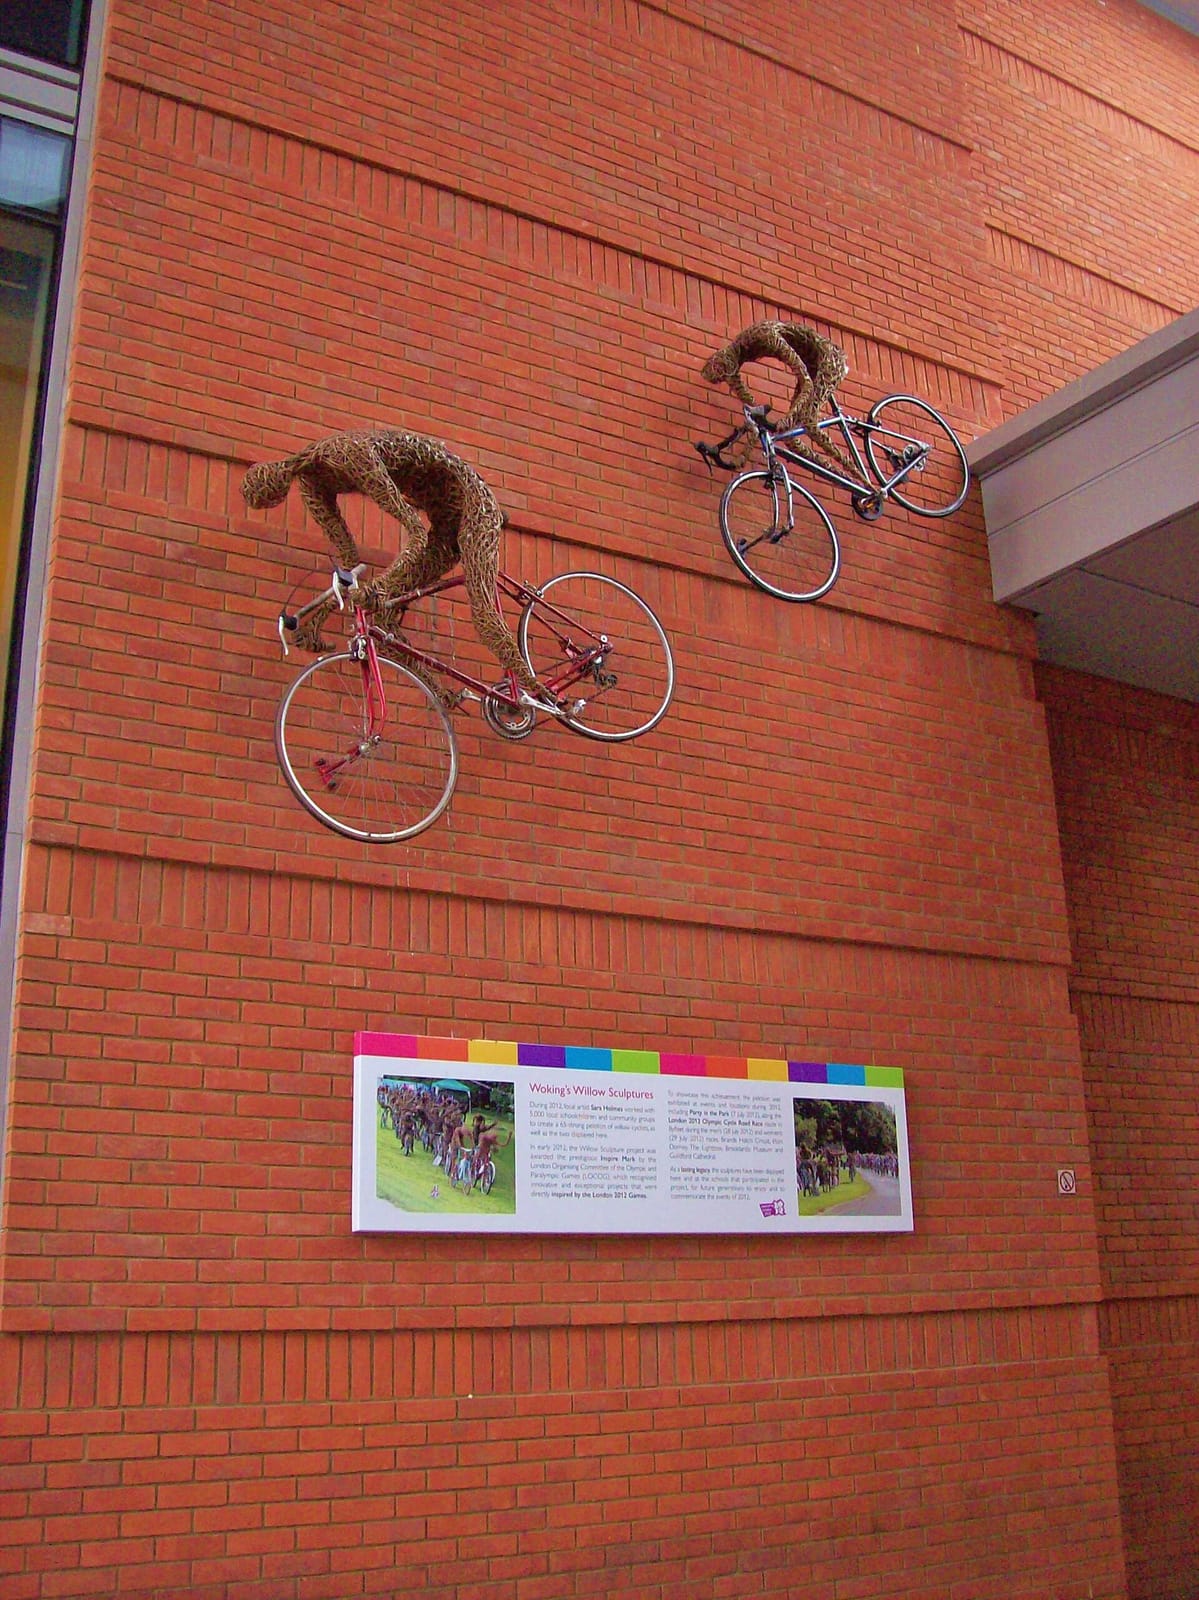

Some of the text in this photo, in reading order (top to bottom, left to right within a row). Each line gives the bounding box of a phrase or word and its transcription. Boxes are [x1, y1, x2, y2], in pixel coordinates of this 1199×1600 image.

[529, 1083, 654, 1100] Woking's Willow Sculptures
[529, 1101, 547, 1111] During
[591, 1103, 601, 1111] Sara
[603, 1104, 623, 1112] Holmes
[609, 1113, 637, 1123] community
[689, 1109, 702, 1117] Party
[586, 1122, 606, 1131] peloton
[702, 1118, 722, 1127] Olympic
[723, 1119, 736, 1127] Cycle
[571, 1130, 594, 1140] displayed
[537, 1143, 550, 1153] early
[579, 1144, 598, 1152] Willow
[600, 1145, 624, 1154] Sculpture
[626, 1146, 644, 1155] project
[569, 1153, 598, 1163] prestigious
[600, 1154, 618, 1164] Inspire
[639, 1155, 645, 1164] by
[580, 1163, 609, 1171] Committee
[626, 1164, 646, 1174] Olympic
[530, 1171, 558, 1180] Paralympic
[574, 1181, 604, 1191] exceptional
[607, 1182, 628, 1191] projects
[531, 1191, 550, 1200] directly
[551, 1191, 573, 1200] inspired
[574, 1191, 580, 1200] by
